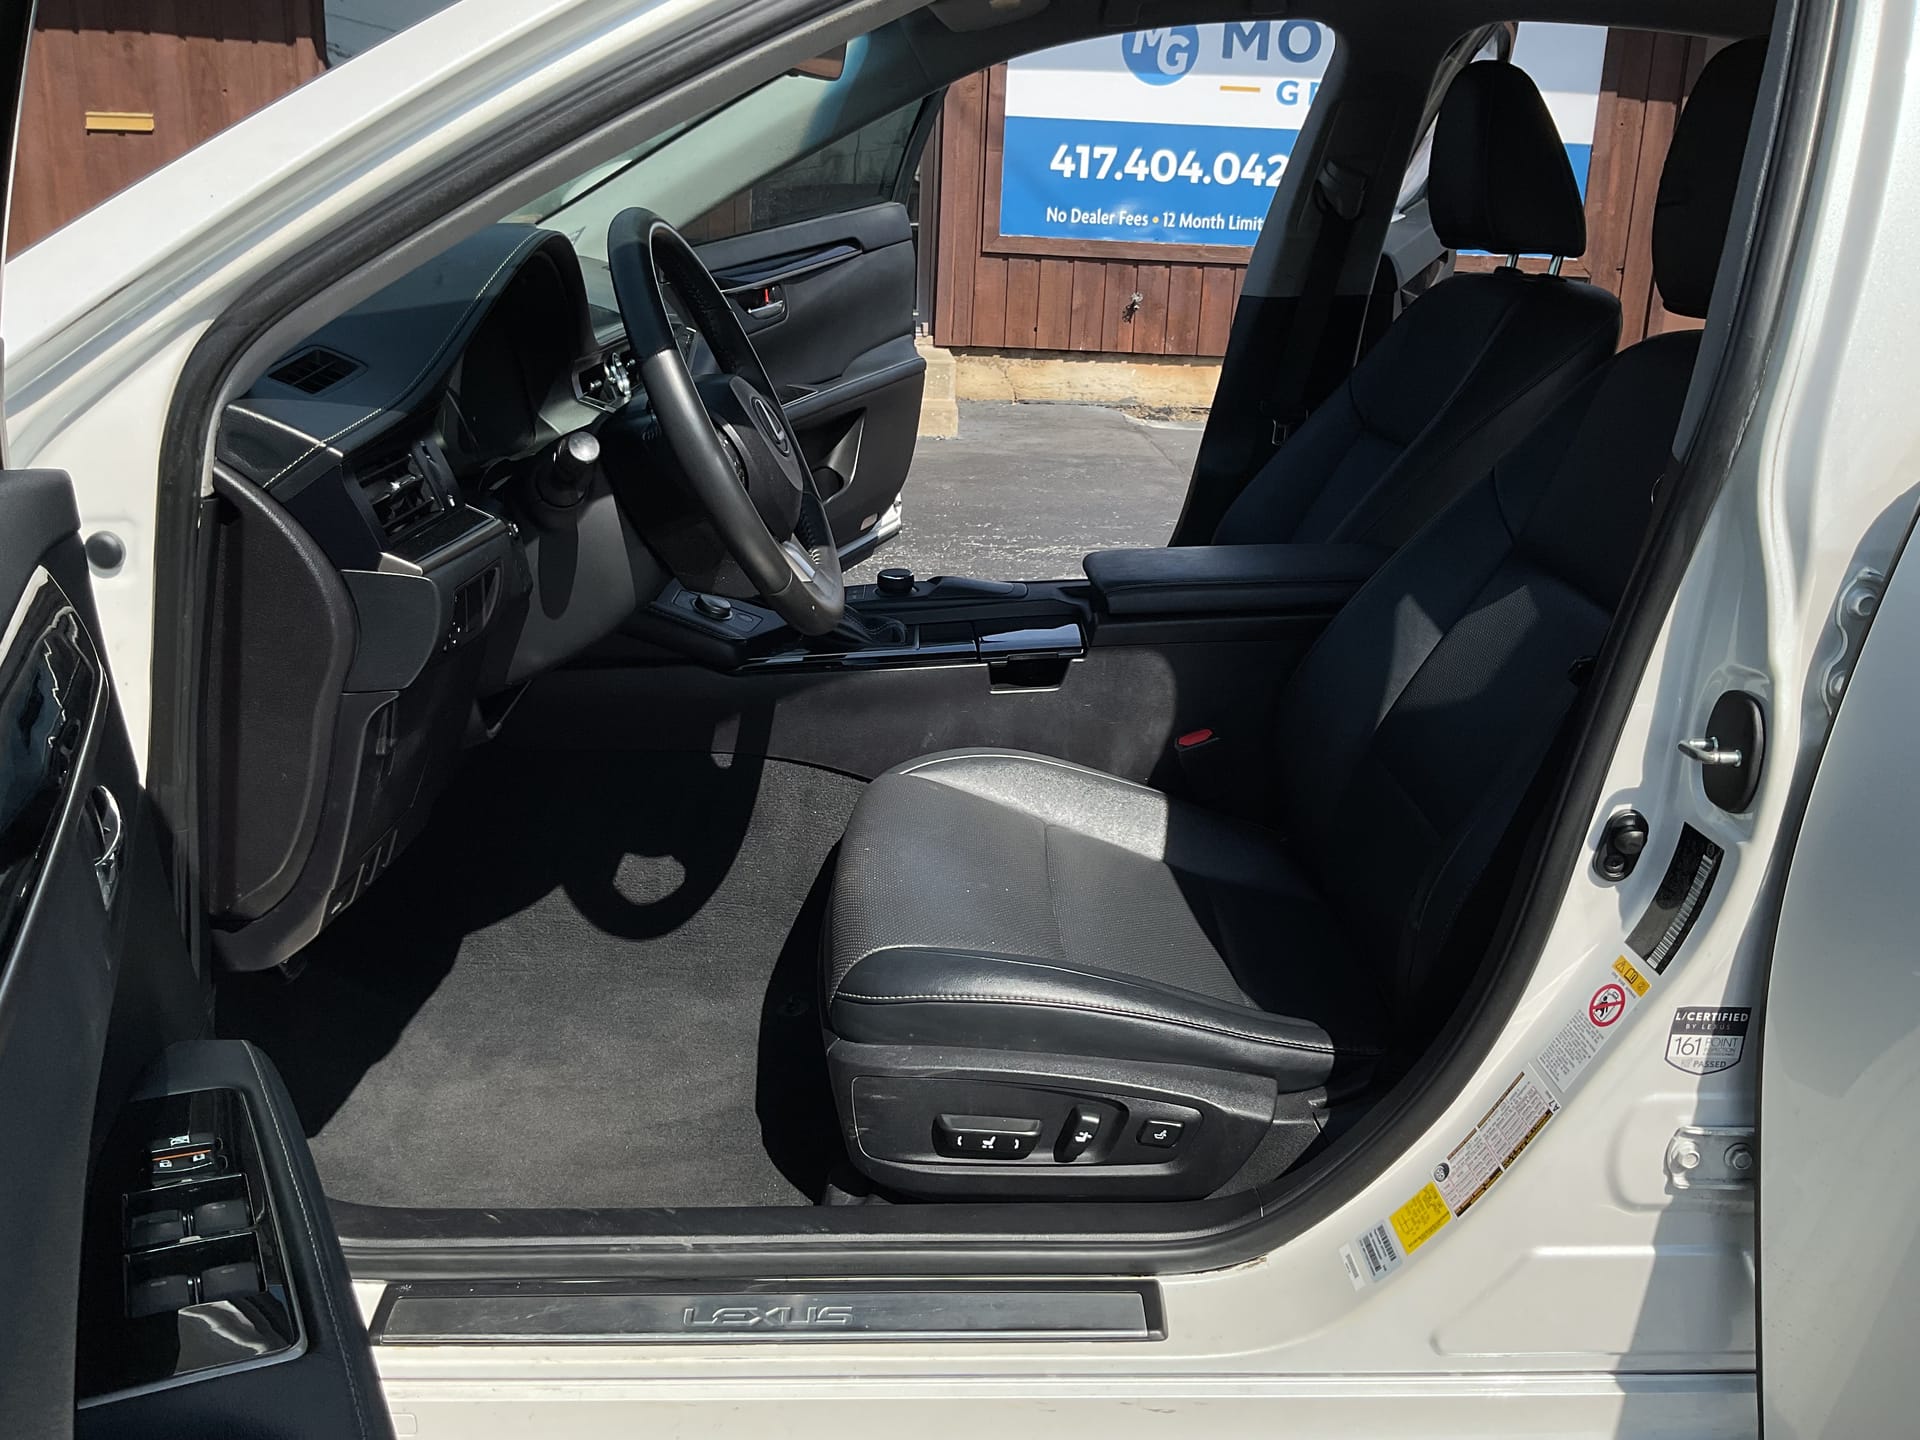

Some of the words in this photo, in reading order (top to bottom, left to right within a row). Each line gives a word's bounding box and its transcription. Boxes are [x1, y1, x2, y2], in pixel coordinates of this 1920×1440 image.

[1050, 144, 1290, 187] 417.404.042
[1046, 206, 1067, 223] No
[1070, 207, 1115, 225] Dealer
[1118, 210, 1148, 226] Fees
[1162, 211, 1176, 228] 12
[1179, 212, 1225, 230] Month
[1228, 214, 1264, 231] Limit
[1675, 1011, 1749, 1022] L/CERTIFIED
[1675, 1036, 1702, 1056] 161
[1692, 1060, 1727, 1068] PASSED
[683, 1306, 853, 1327] LEXUS
